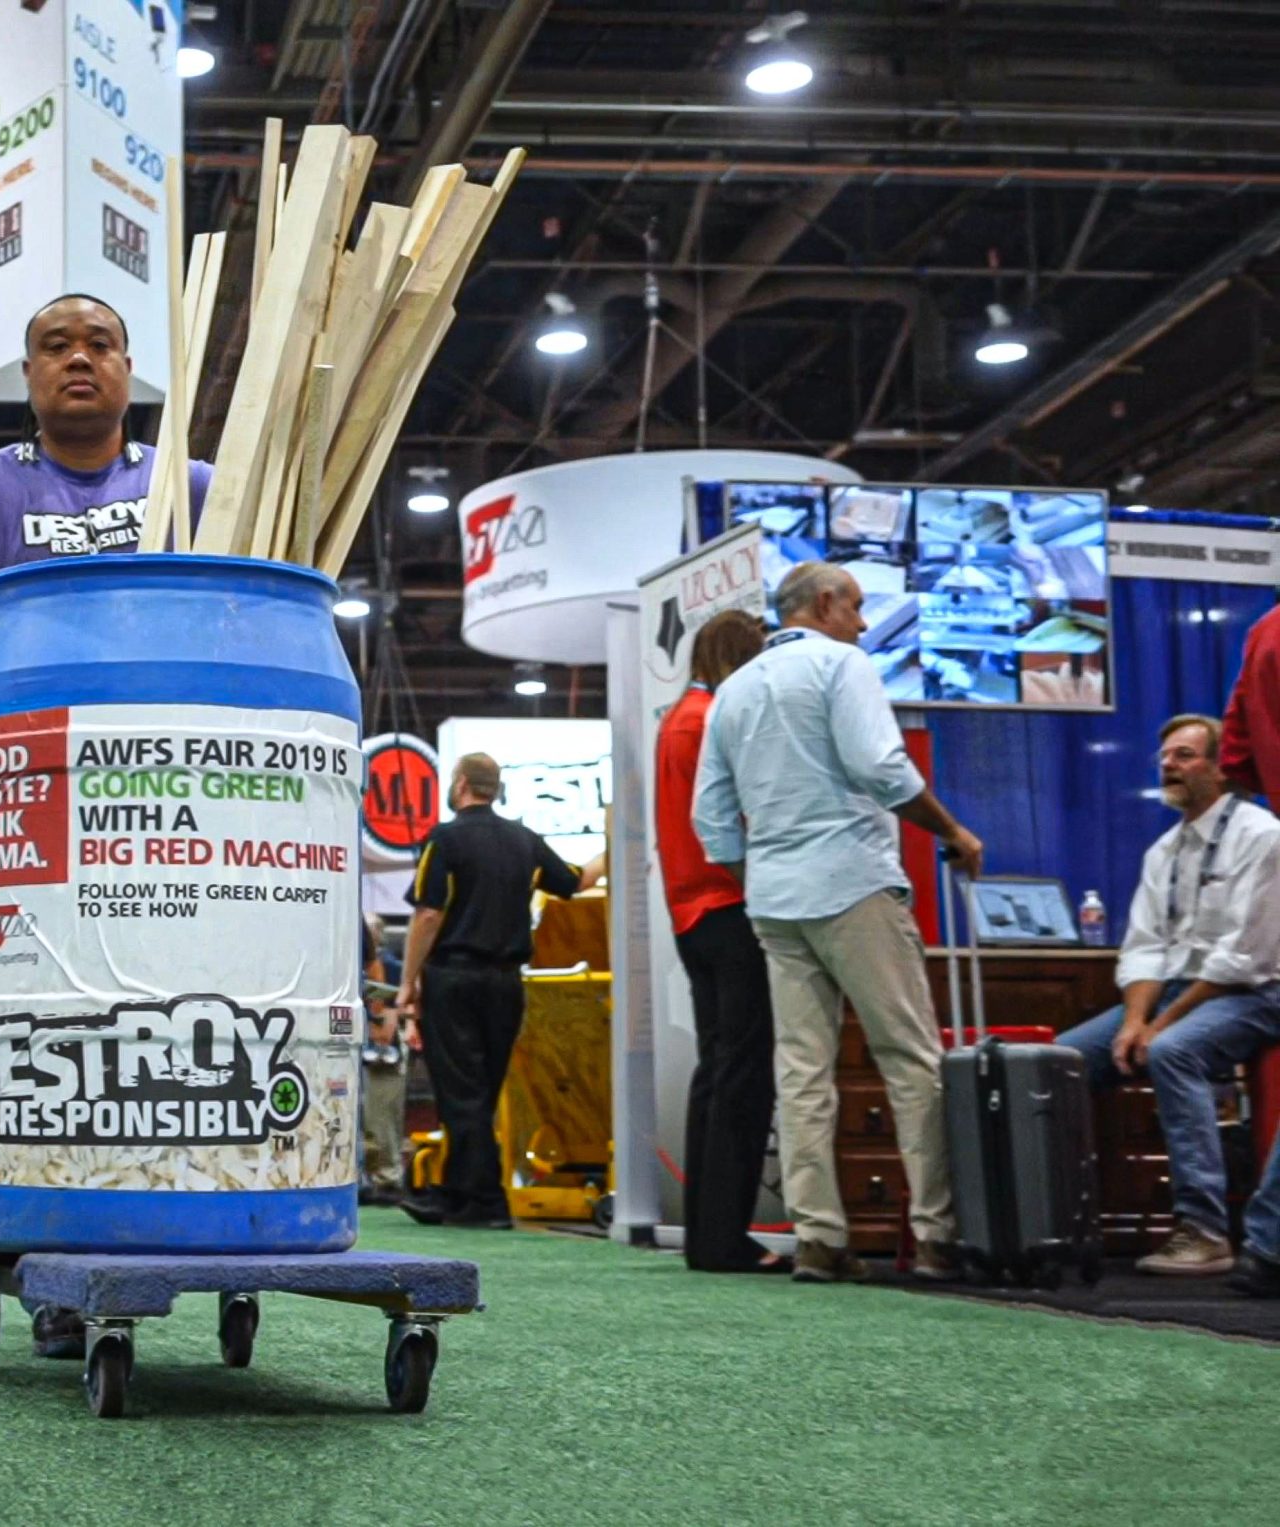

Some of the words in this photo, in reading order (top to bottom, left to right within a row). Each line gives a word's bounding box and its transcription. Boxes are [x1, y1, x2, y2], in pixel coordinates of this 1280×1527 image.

[74, 13, 116, 64] AISLE
[73, 57, 127, 118] 9100
[124, 134, 165, 183] 920
[682, 542, 759, 612] LEGACY
[77, 738, 174, 767] AWFS
[184, 739, 255, 768] FAIR
[263, 741, 326, 772] 2019
[332, 748, 348, 776] IS
[78, 770, 190, 799] GOING
[201, 771, 304, 802] GREEN
[78, 804, 162, 832] WITH
[172, 804, 198, 832] A
[80, 838, 133, 867] BIG
[144, 838, 213, 867] RED
[78, 883, 156, 900] FOLLOW
[163, 883, 199, 900] THE
[206, 884, 267, 902] GREEN
[272, 886, 327, 904] CARPET
[78, 902, 101, 918] TO
[108, 902, 142, 918] SEE
[149, 902, 198, 918] HOW
[272, 1135, 295, 1150] TM
